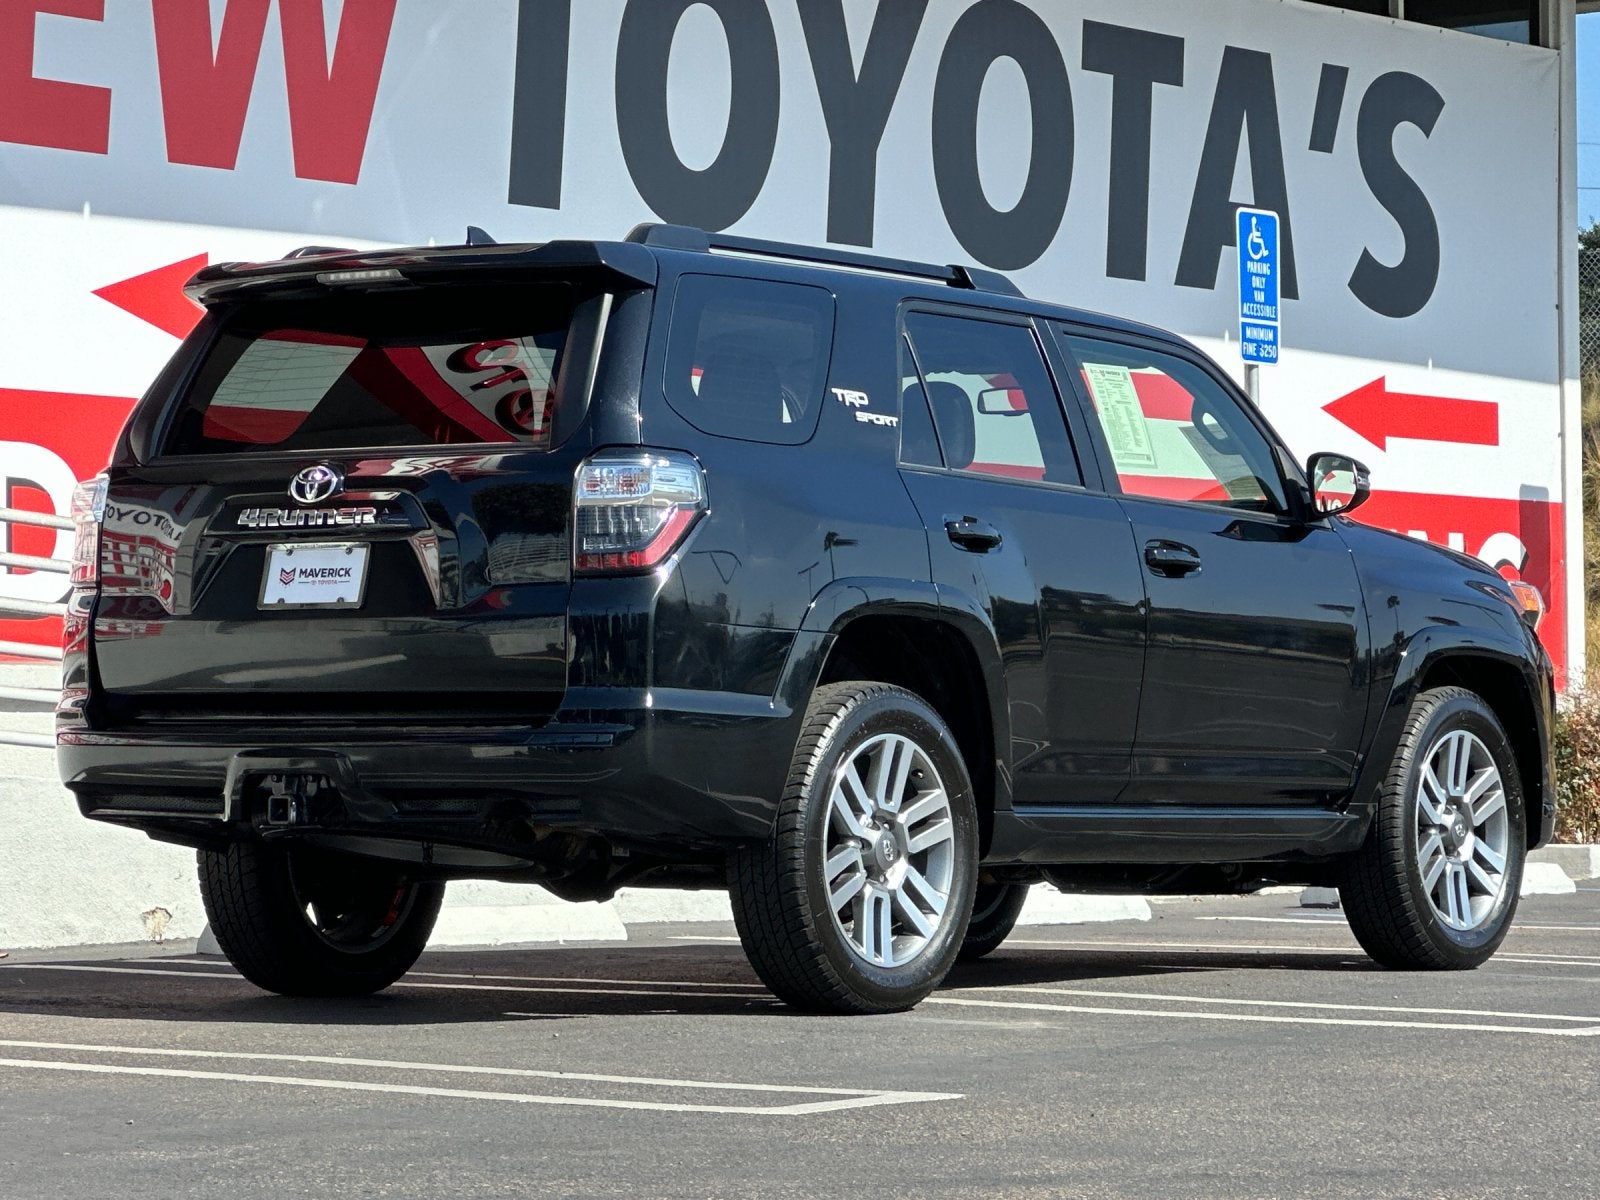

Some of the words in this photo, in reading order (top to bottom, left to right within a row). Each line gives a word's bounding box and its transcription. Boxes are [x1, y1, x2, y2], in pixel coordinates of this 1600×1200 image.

[1247, 261, 1271, 276] PARKING
[1252, 276, 1266, 289] ONLY
[1253, 289, 1265, 303] VAN
[1243, 302, 1276, 319] ACCESSIBLE
[1246, 326, 1274, 341] MINIMUM
[1243, 341, 1257, 357] FINE
[831, 387, 869, 408] TRD
[855, 411, 899, 428] SPORT
[237, 506, 377, 528] 4RUNNER
[298, 567, 353, 578] MAVERICK
